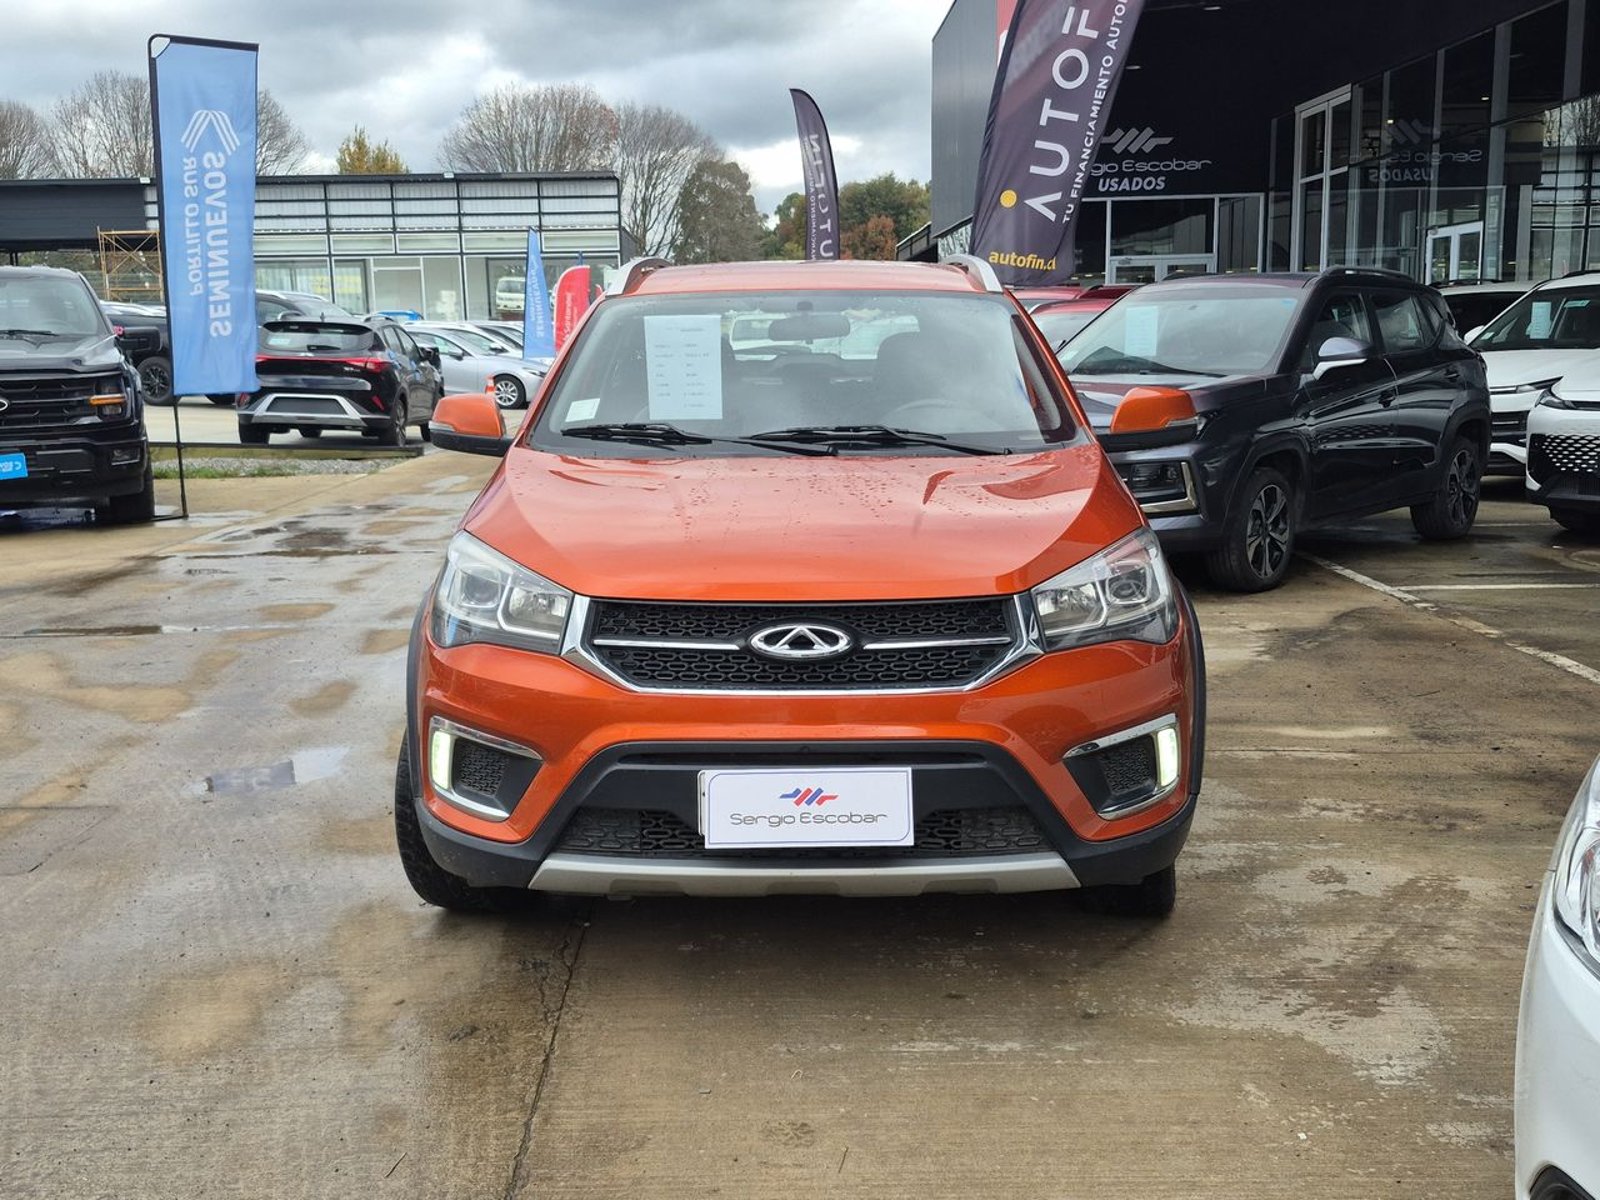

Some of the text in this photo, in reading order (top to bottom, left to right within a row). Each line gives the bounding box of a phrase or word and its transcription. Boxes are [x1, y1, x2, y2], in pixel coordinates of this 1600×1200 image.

[1062, 203, 1074, 223] TU
[1071, 55, 1114, 199] FINANCIAMIENTO
[1090, 157, 1212, 176] gio Escobar
[1098, 176, 1166, 192] USADOS
[730, 811, 888, 828] Sergio Escobar
